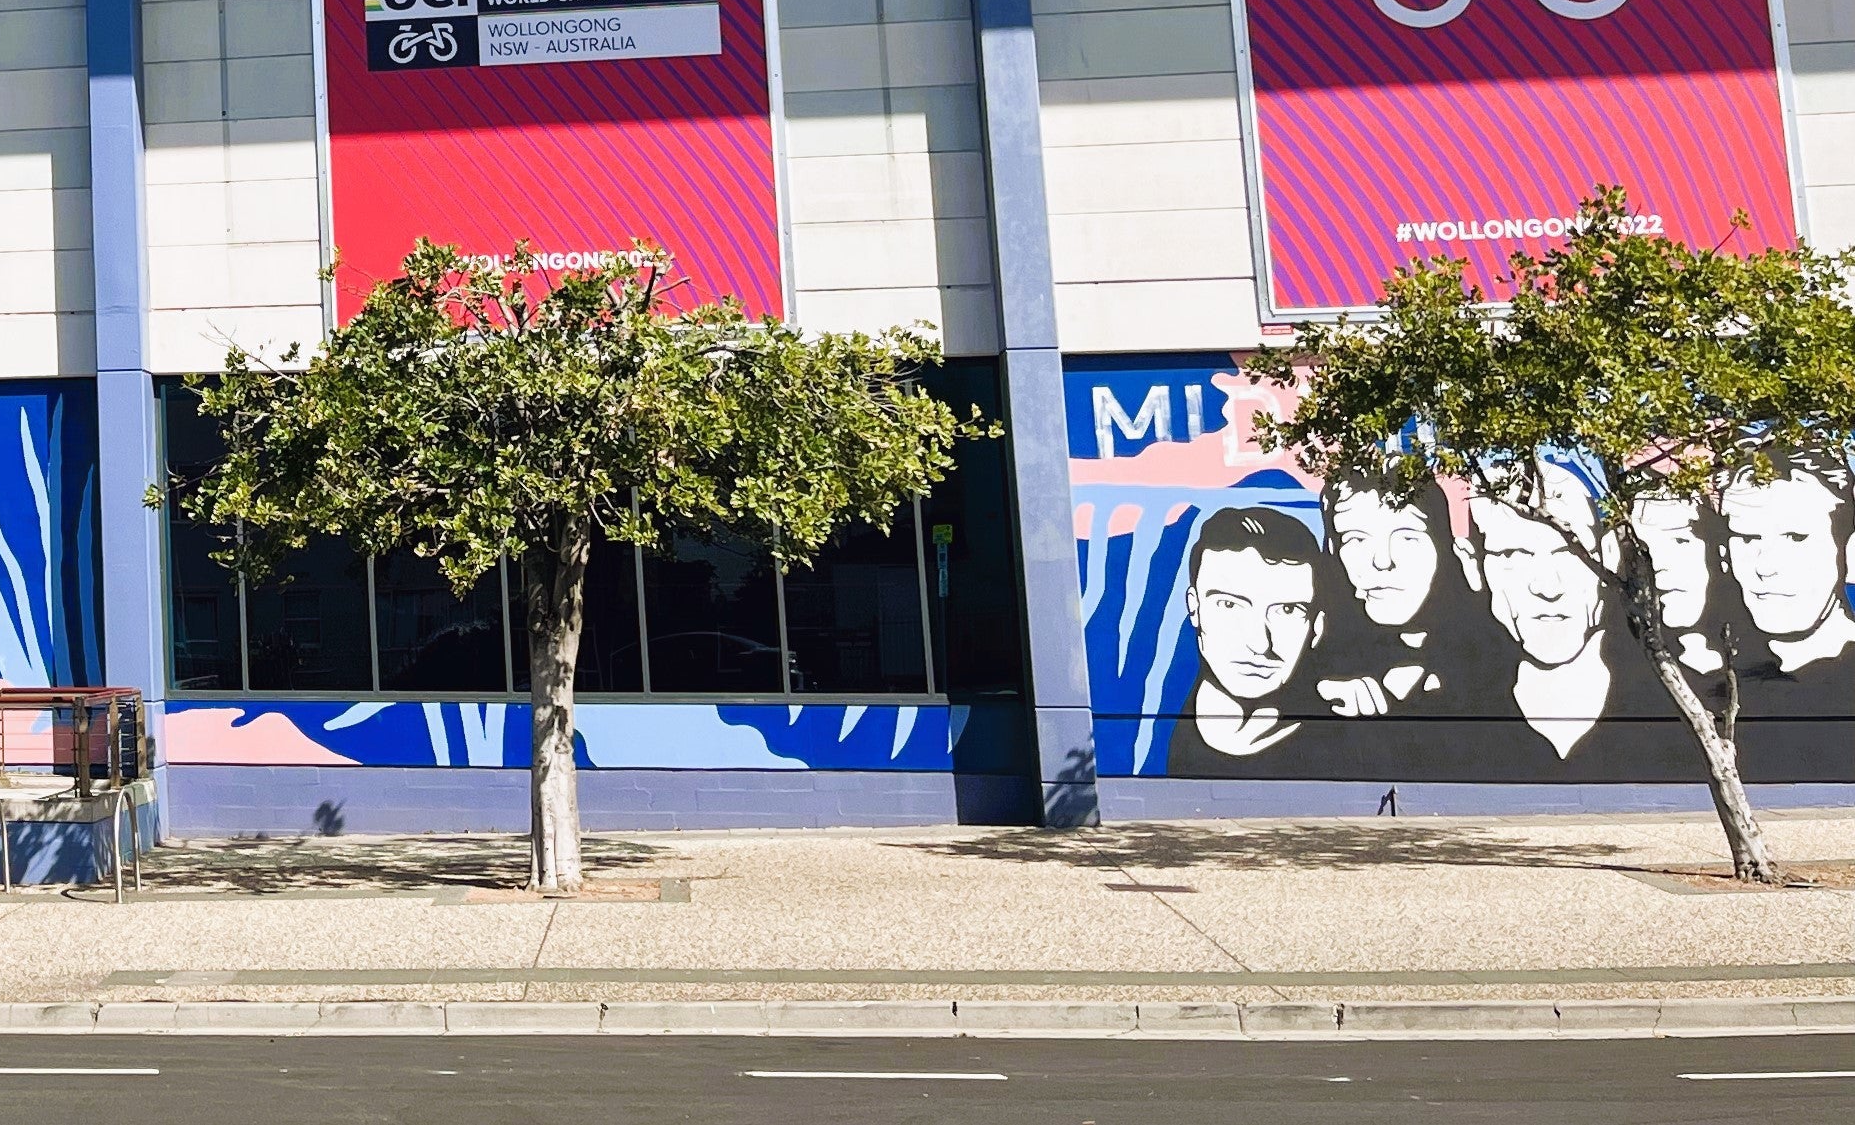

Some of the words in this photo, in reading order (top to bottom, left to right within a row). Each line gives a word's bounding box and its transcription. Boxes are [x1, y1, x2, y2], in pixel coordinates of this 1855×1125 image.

[487, 17, 622, 38] WOLLONGONG
[490, 41, 529, 57] NSW
[546, 35, 637, 54] AUSTRALIA
